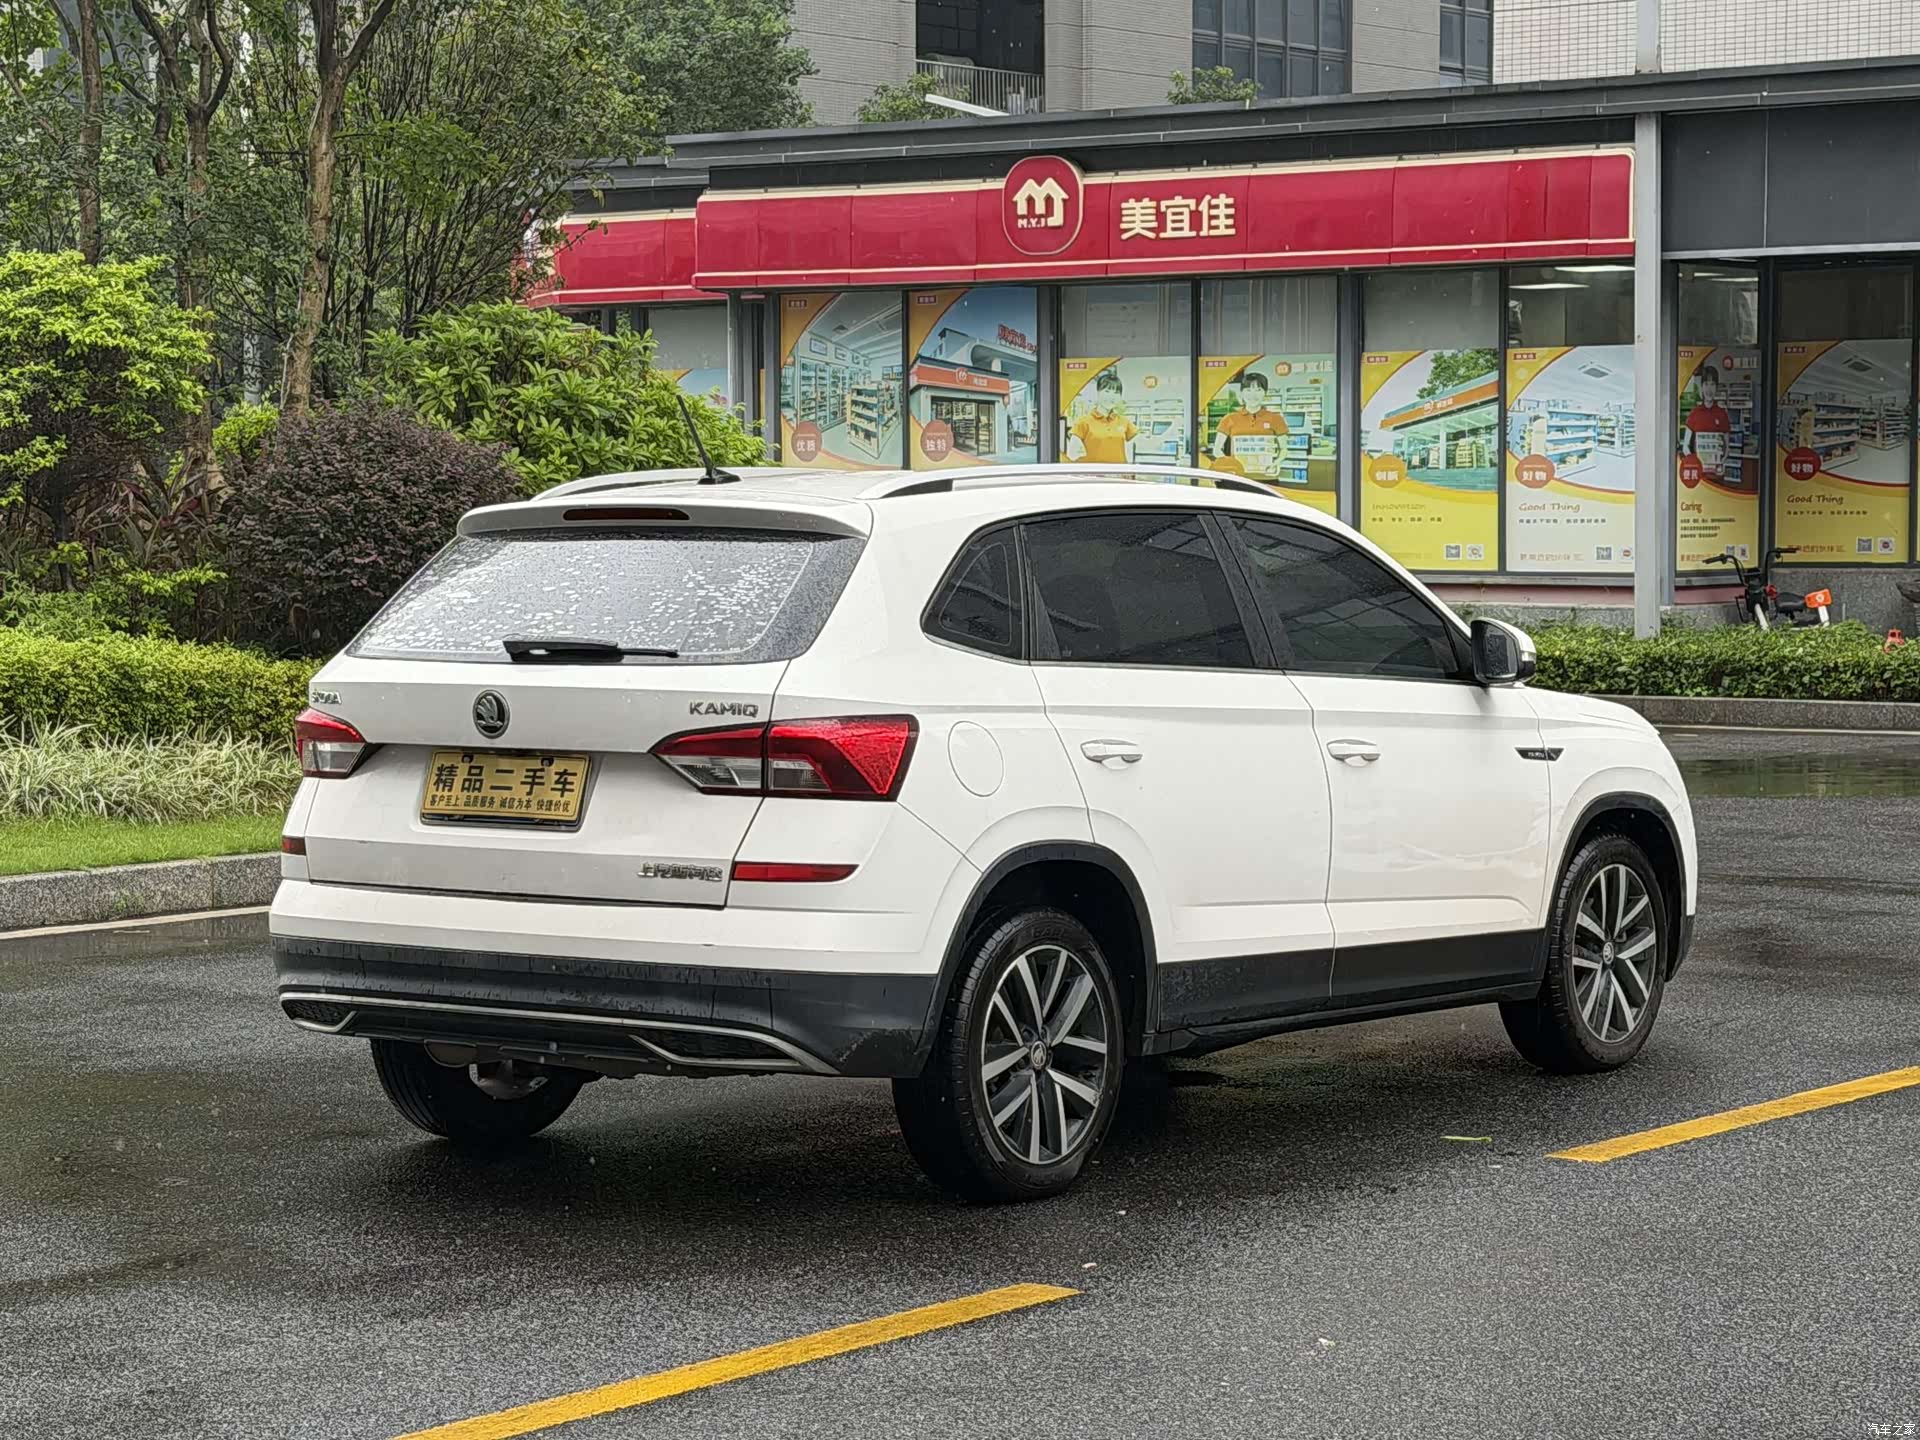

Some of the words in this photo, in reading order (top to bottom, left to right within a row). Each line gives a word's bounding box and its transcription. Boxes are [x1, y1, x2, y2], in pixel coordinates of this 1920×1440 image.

[1120, 193, 1236, 240] 美宜佳
[1680, 501, 1702, 514] Caring
[1786, 494, 1813, 504] Good
[1815, 494, 1844, 505] Thing
[1518, 502, 1546, 511] Good
[1550, 502, 1581, 514] Thing
[689, 702, 759, 718] KAMIQ
[433, 763, 578, 798] 精品二手车
[429, 794, 460, 807] 客户至上
[463, 796, 496, 809] 品质服务
[499, 796, 533, 811] 诚信为本
[536, 798, 571, 813] 快捷价优
